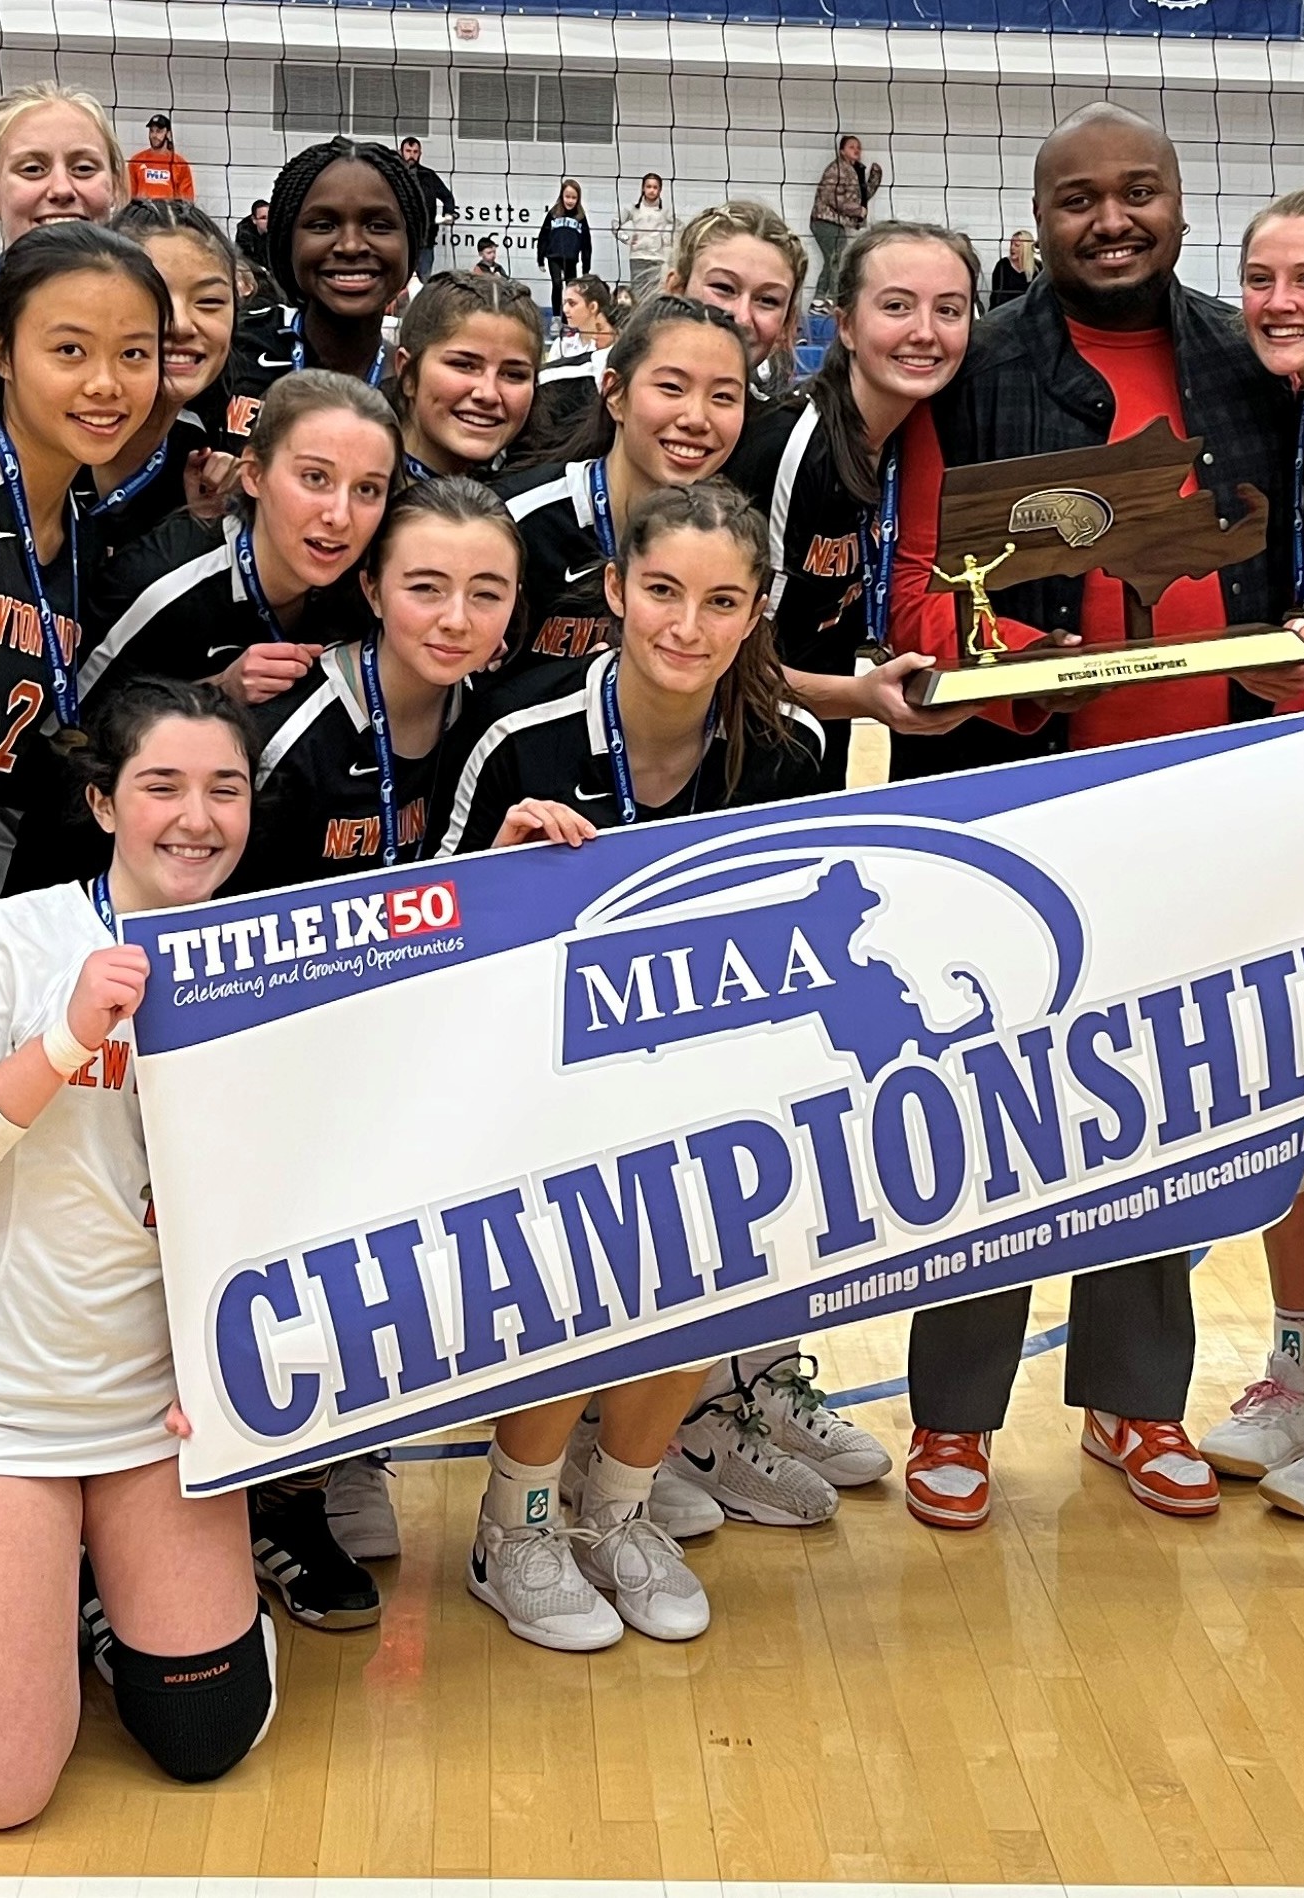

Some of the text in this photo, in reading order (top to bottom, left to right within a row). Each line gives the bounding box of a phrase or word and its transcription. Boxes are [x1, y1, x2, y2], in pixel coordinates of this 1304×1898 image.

[1016, 508, 1061, 526] MIAA
[1105, 665, 1132, 677] STATE
[1134, 658, 1187, 674] CHAMPIONS
[157, 905, 327, 982] TITLE
[173, 935, 465, 1007] Celebrating and Growing Opportunities
[576, 926, 837, 1032] MIAA
[809, 1264, 920, 1319] Building
[924, 1244, 968, 1284] the
[971, 1222, 1052, 1267] Future
[1056, 1185, 1160, 1240] Through
[1163, 1133, 1299, 1205] Educational
